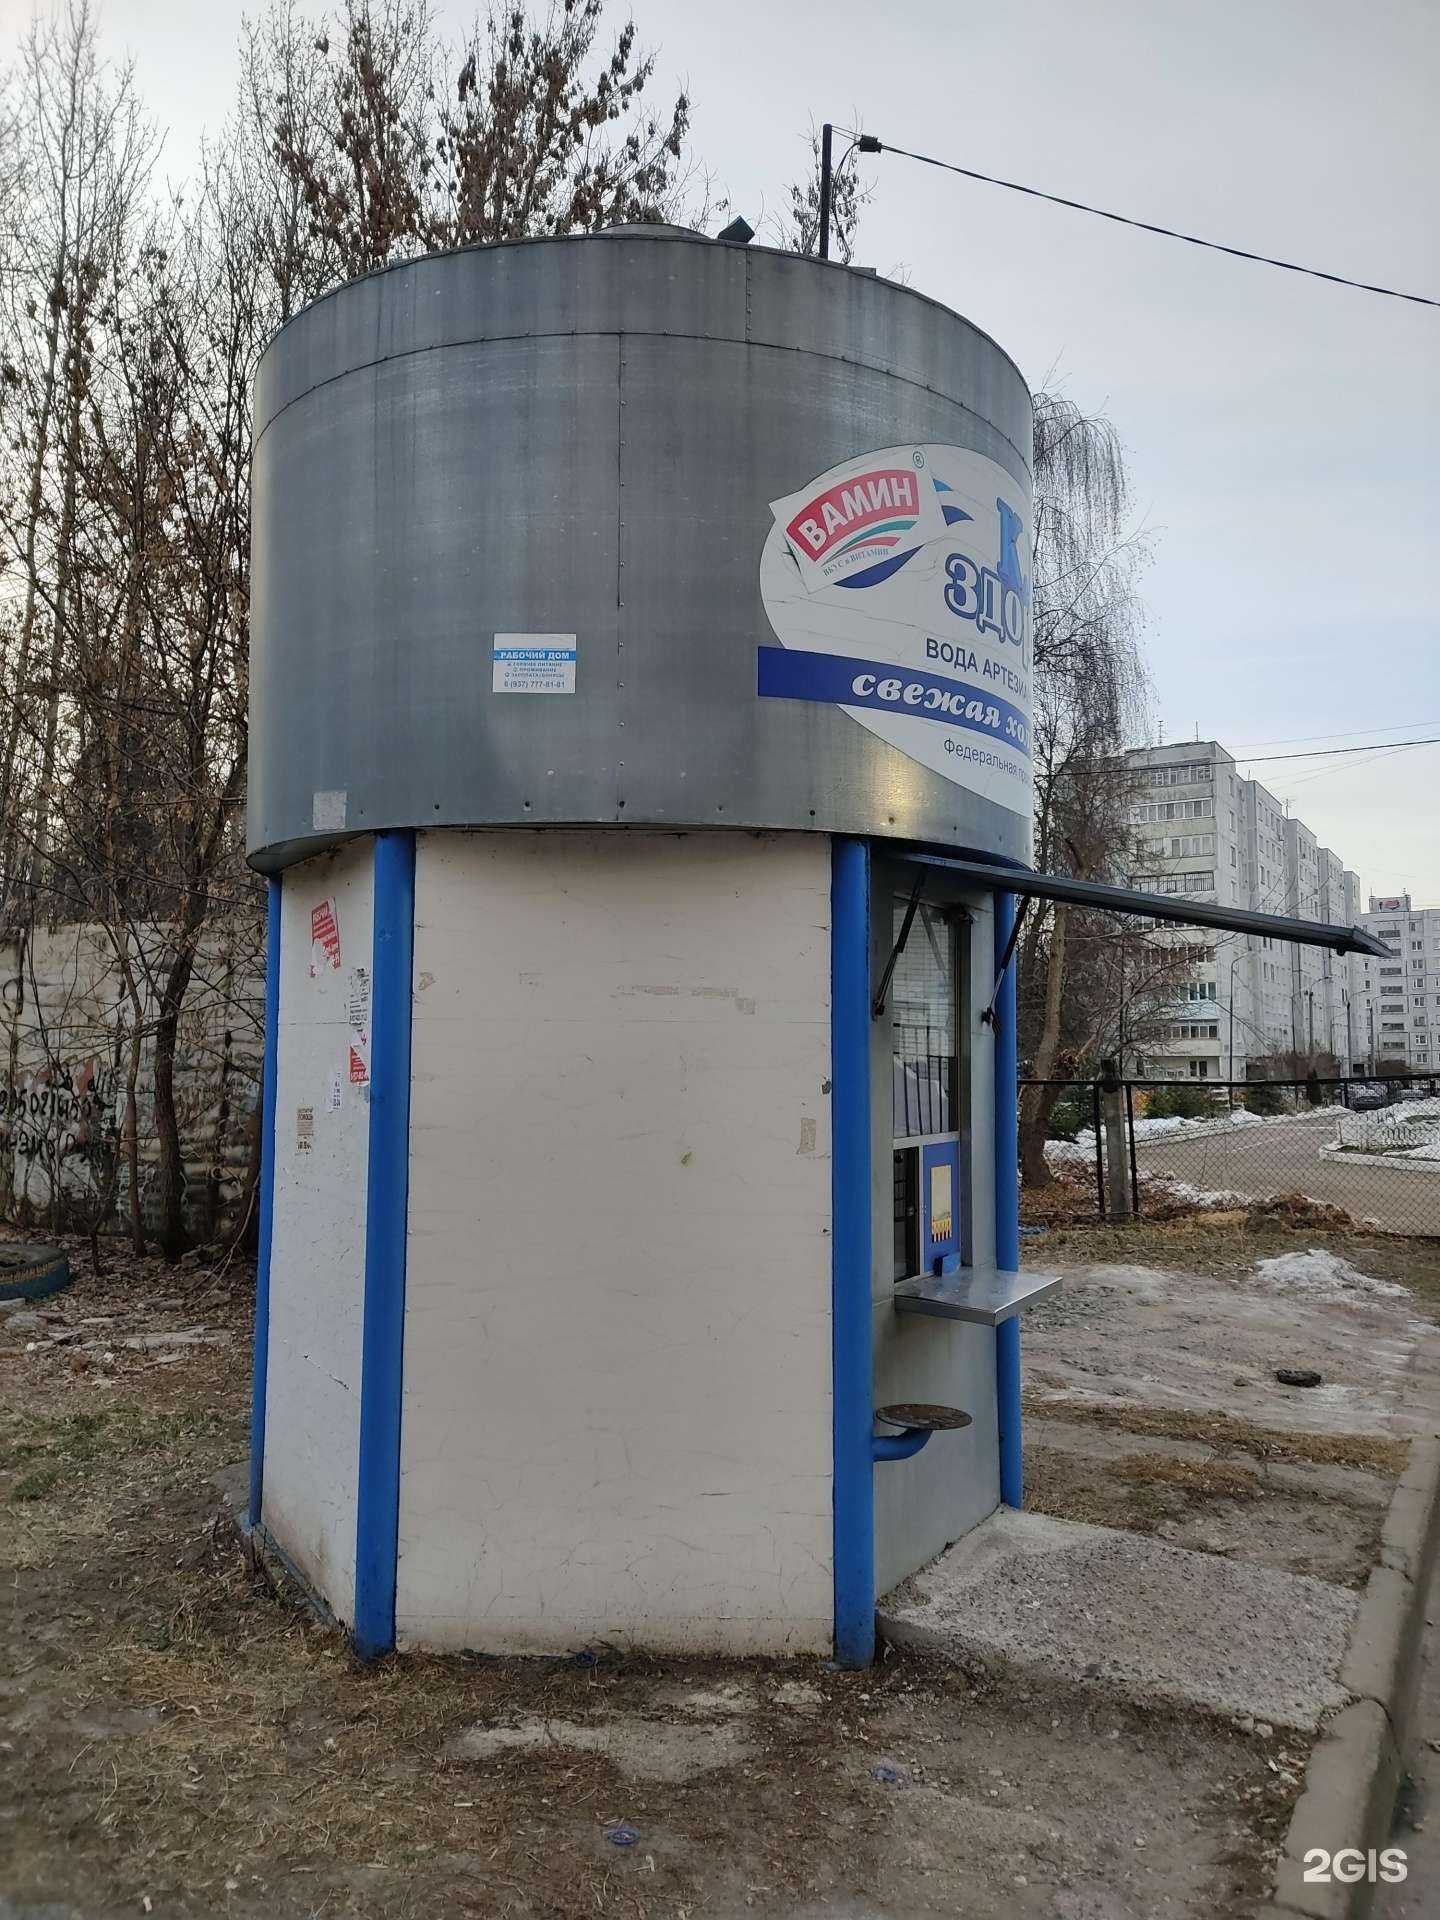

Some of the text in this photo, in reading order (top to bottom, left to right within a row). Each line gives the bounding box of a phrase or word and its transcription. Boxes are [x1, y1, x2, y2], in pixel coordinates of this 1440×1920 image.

[798, 478, 914, 552] ВАМИН
[500, 651, 569, 660] РАБОЧИЙ ДОМ
[926, 638, 979, 673] ВОДА
[852, 674, 1002, 729] свежая
[943, 738, 1018, 777] Федеральная
